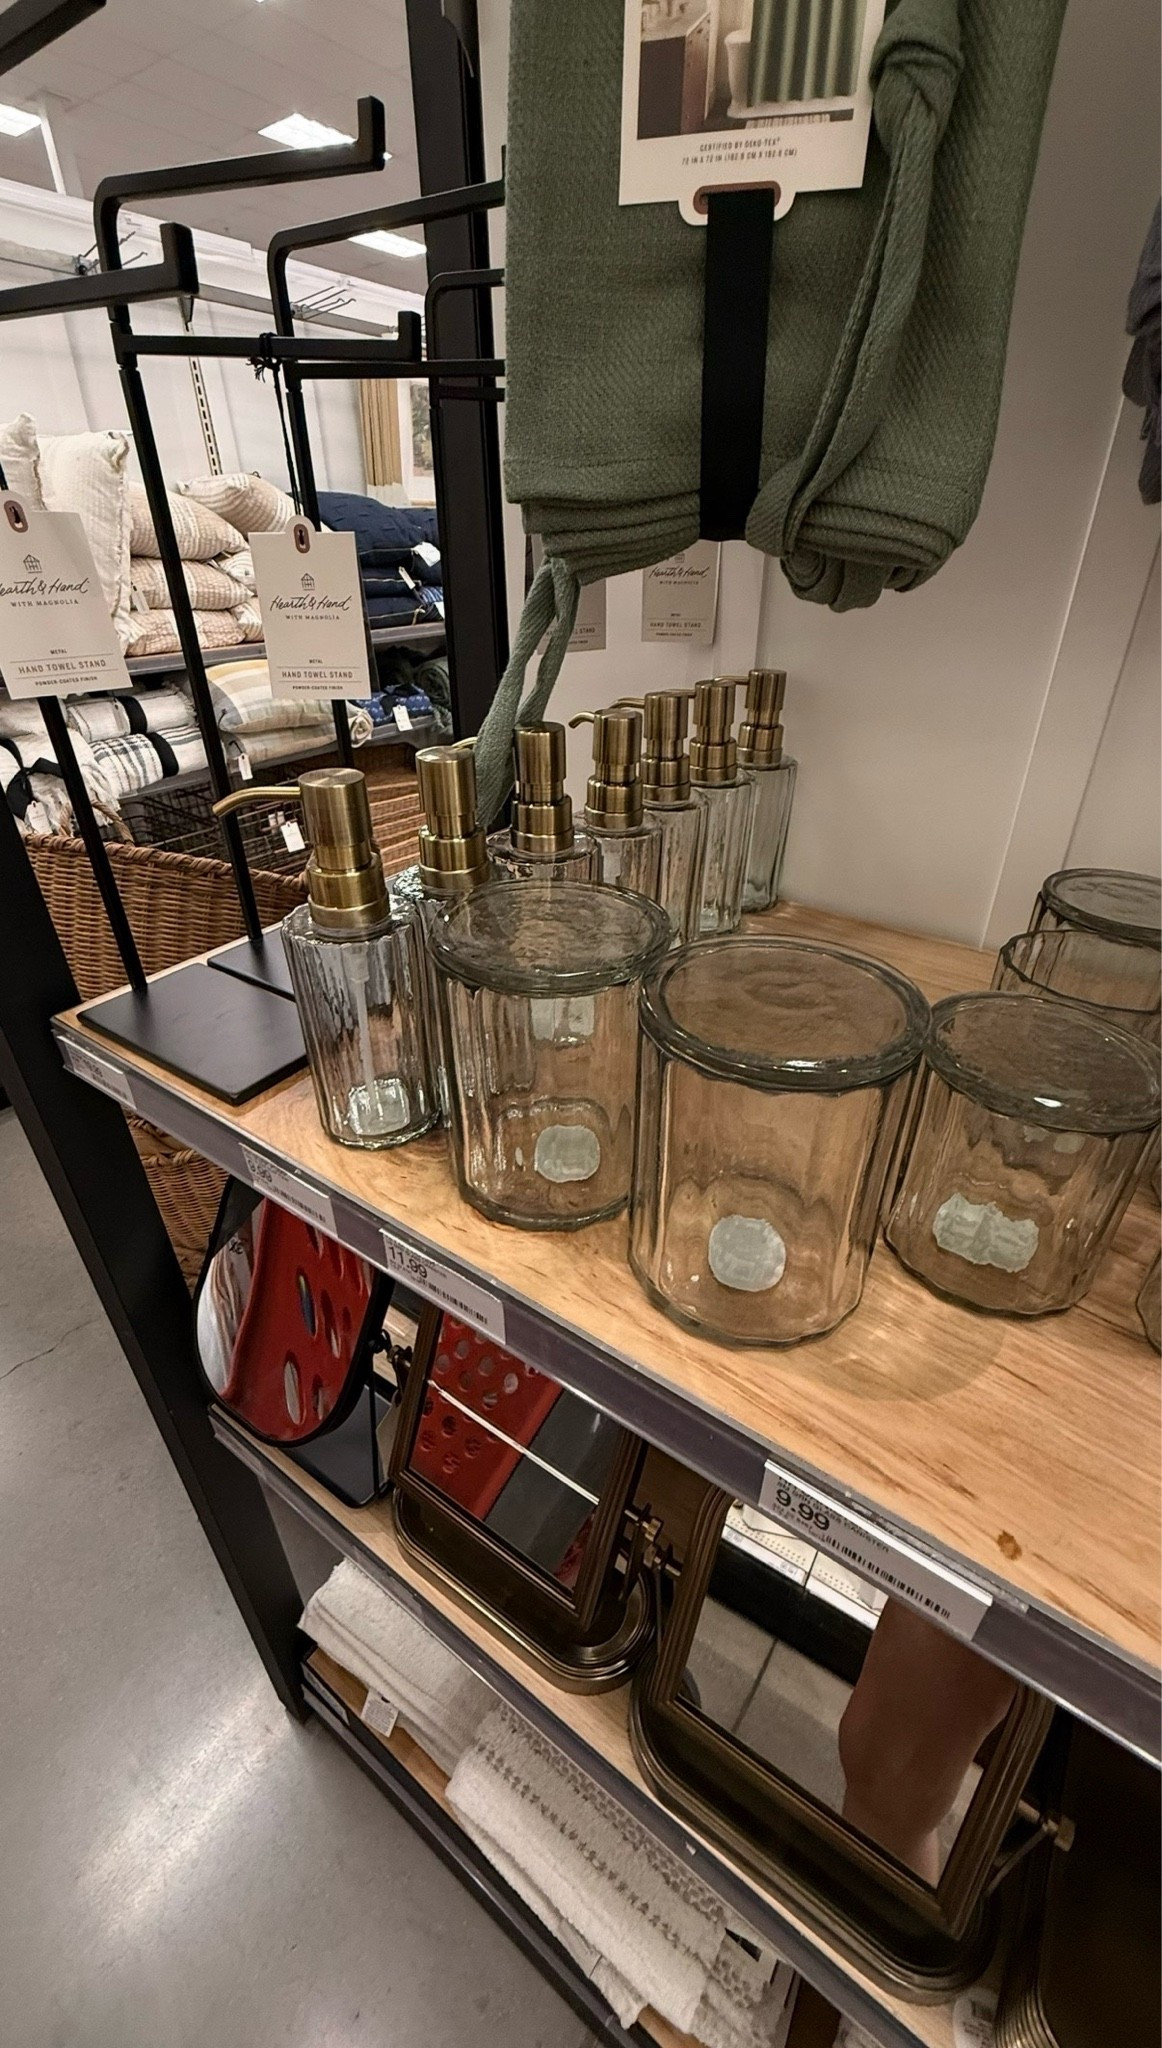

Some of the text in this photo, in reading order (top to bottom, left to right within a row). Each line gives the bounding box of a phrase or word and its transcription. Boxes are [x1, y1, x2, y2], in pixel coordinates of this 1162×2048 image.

[0, 577, 37, 596] earth
[48, 578, 88, 594] Hand
[270, 594, 310, 611] Hearth
[316, 595, 352, 611] Hand
[18, 659, 106, 674] HAND TOWEL STAND
[388, 1246, 428, 1279] 11.99
[776, 1489, 830, 1531] 9.99
